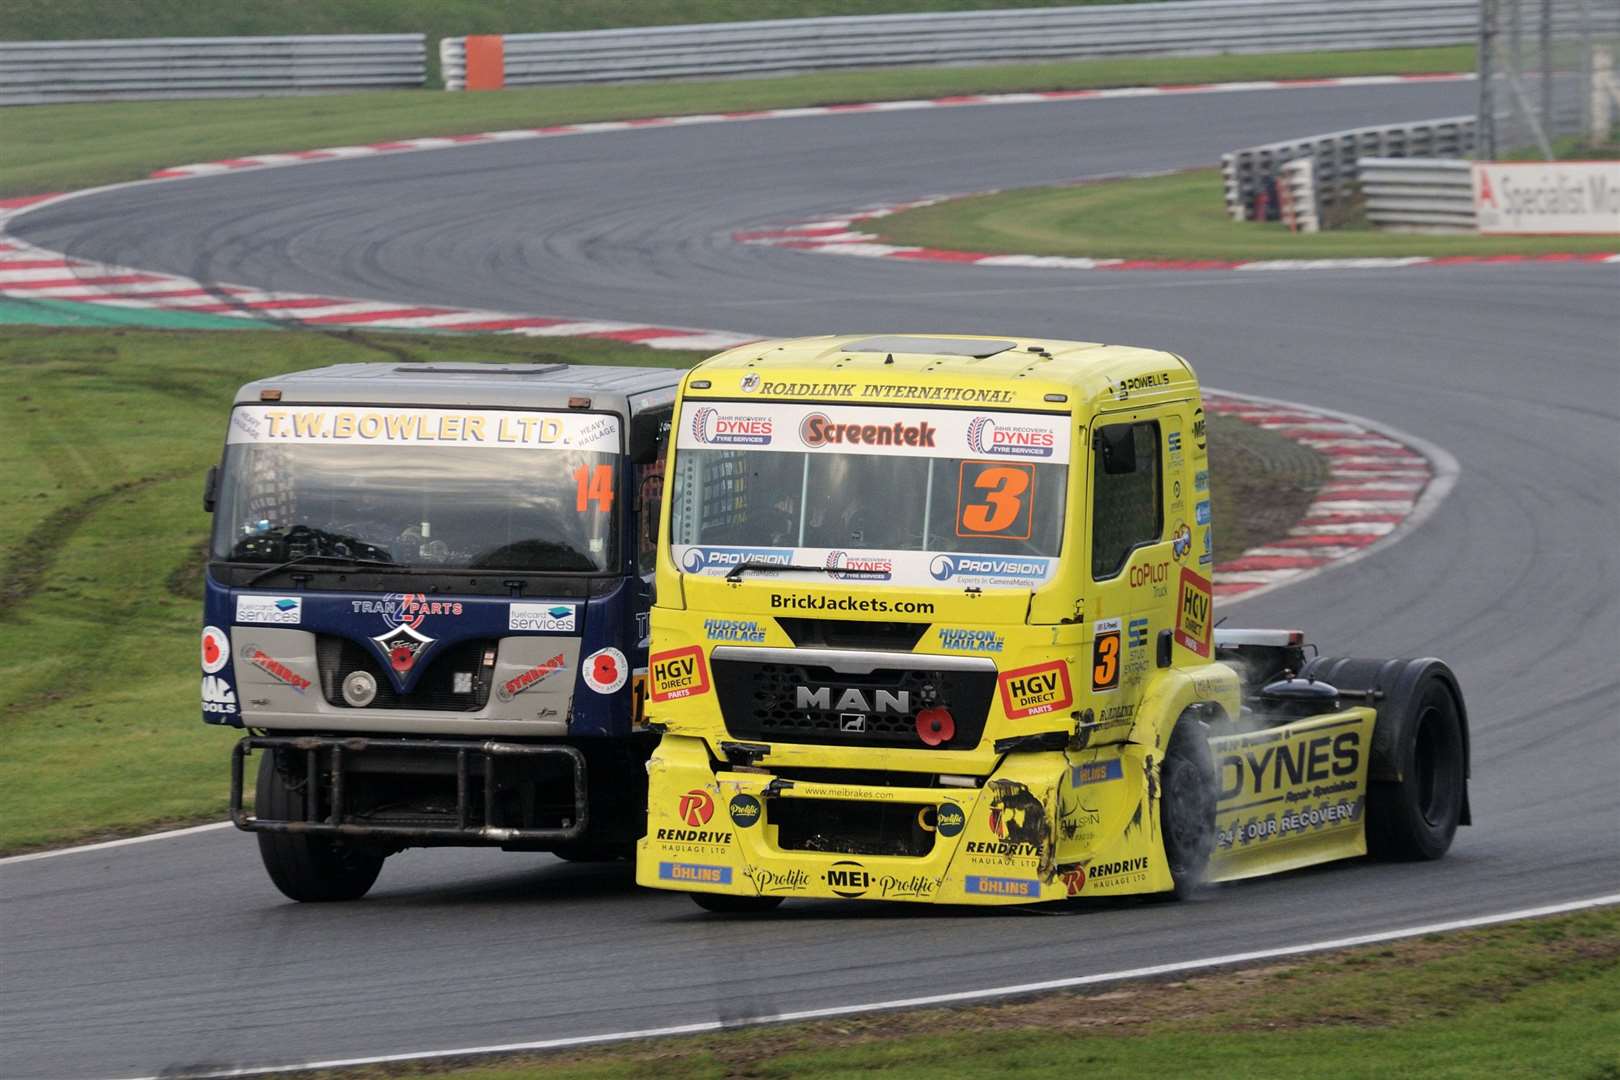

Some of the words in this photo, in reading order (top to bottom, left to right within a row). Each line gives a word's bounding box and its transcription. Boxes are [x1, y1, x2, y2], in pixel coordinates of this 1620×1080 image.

[1501, 175, 1587, 226] Specialist
[760, 382, 857, 396] ROADLINK
[860, 384, 1015, 403] INTERNATIONAL
[498, 415, 571, 445] LTD.
[580, 418, 606, 435] HEAVY
[715, 421, 773, 434] DYNES
[808, 418, 936, 448] Screentek
[578, 424, 617, 448] HAULAGE
[993, 431, 1054, 446] DYNES
[573, 463, 615, 513] 14
[961, 466, 1030, 532] 3
[846, 561, 892, 572] DYNES
[771, 594, 935, 614] BrickJackets.com
[1183, 587, 1208, 623] HGV
[510, 618, 575, 630] services
[703, 618, 758, 631] HUDSON
[707, 630, 766, 642] HAULAGE
[938, 628, 995, 641] HUDSON
[942, 640, 1004, 652] HAULAGE
[655, 657, 695, 682] HGV
[1095, 636, 1119, 685] 3
[505, 653, 565, 694] SYNERGY
[661, 677, 692, 690] DIRECT
[1010, 672, 1057, 698] HGV
[667, 688, 690, 699] PARTS
[796, 686, 910, 713] MAN
[1019, 691, 1055, 707] DIRECT
[1028, 704, 1053, 715] PARTS
[1216, 732, 1361, 799] DYNES
[805, 786, 895, 800] www.meibrakes.com
[1217, 832, 1234, 846] 24
[1281, 804, 1355, 831] RECOVERY
[656, 829, 733, 844] RENDRIVE
[662, 844, 705, 853] HAULAGE
[710, 847, 727, 855] LTD
[965, 841, 1044, 857] RENDRIVE
[971, 857, 1017, 867] HAULAGE
[1020, 859, 1037, 868] LTD
[1088, 857, 1149, 879] RENDRIVE
[757, 868, 811, 892] Prolific
[827, 870, 870, 888] MEI
[880, 874, 934, 897] Prolific
[1093, 878, 1131, 889] HAULAGE
